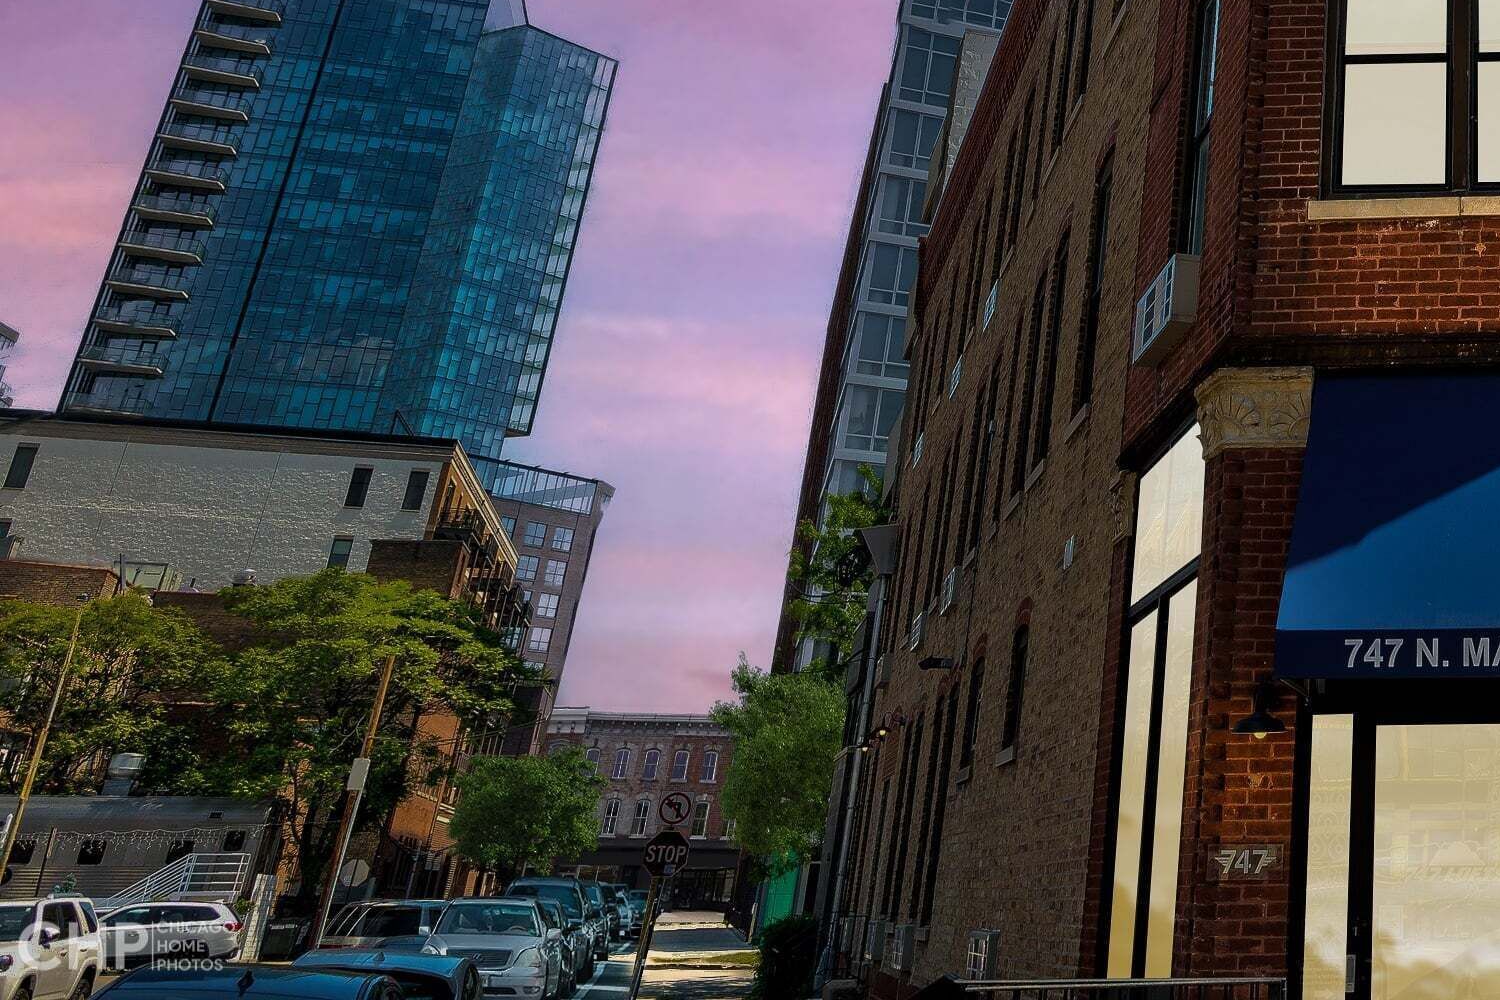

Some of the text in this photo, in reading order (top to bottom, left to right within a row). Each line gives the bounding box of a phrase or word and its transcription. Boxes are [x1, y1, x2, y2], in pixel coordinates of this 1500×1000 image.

[1344, 638, 1404, 668] 747
[1416, 637, 1449, 668] N.
[645, 844, 687, 863] STOP
[1220, 849, 1269, 874] 747
